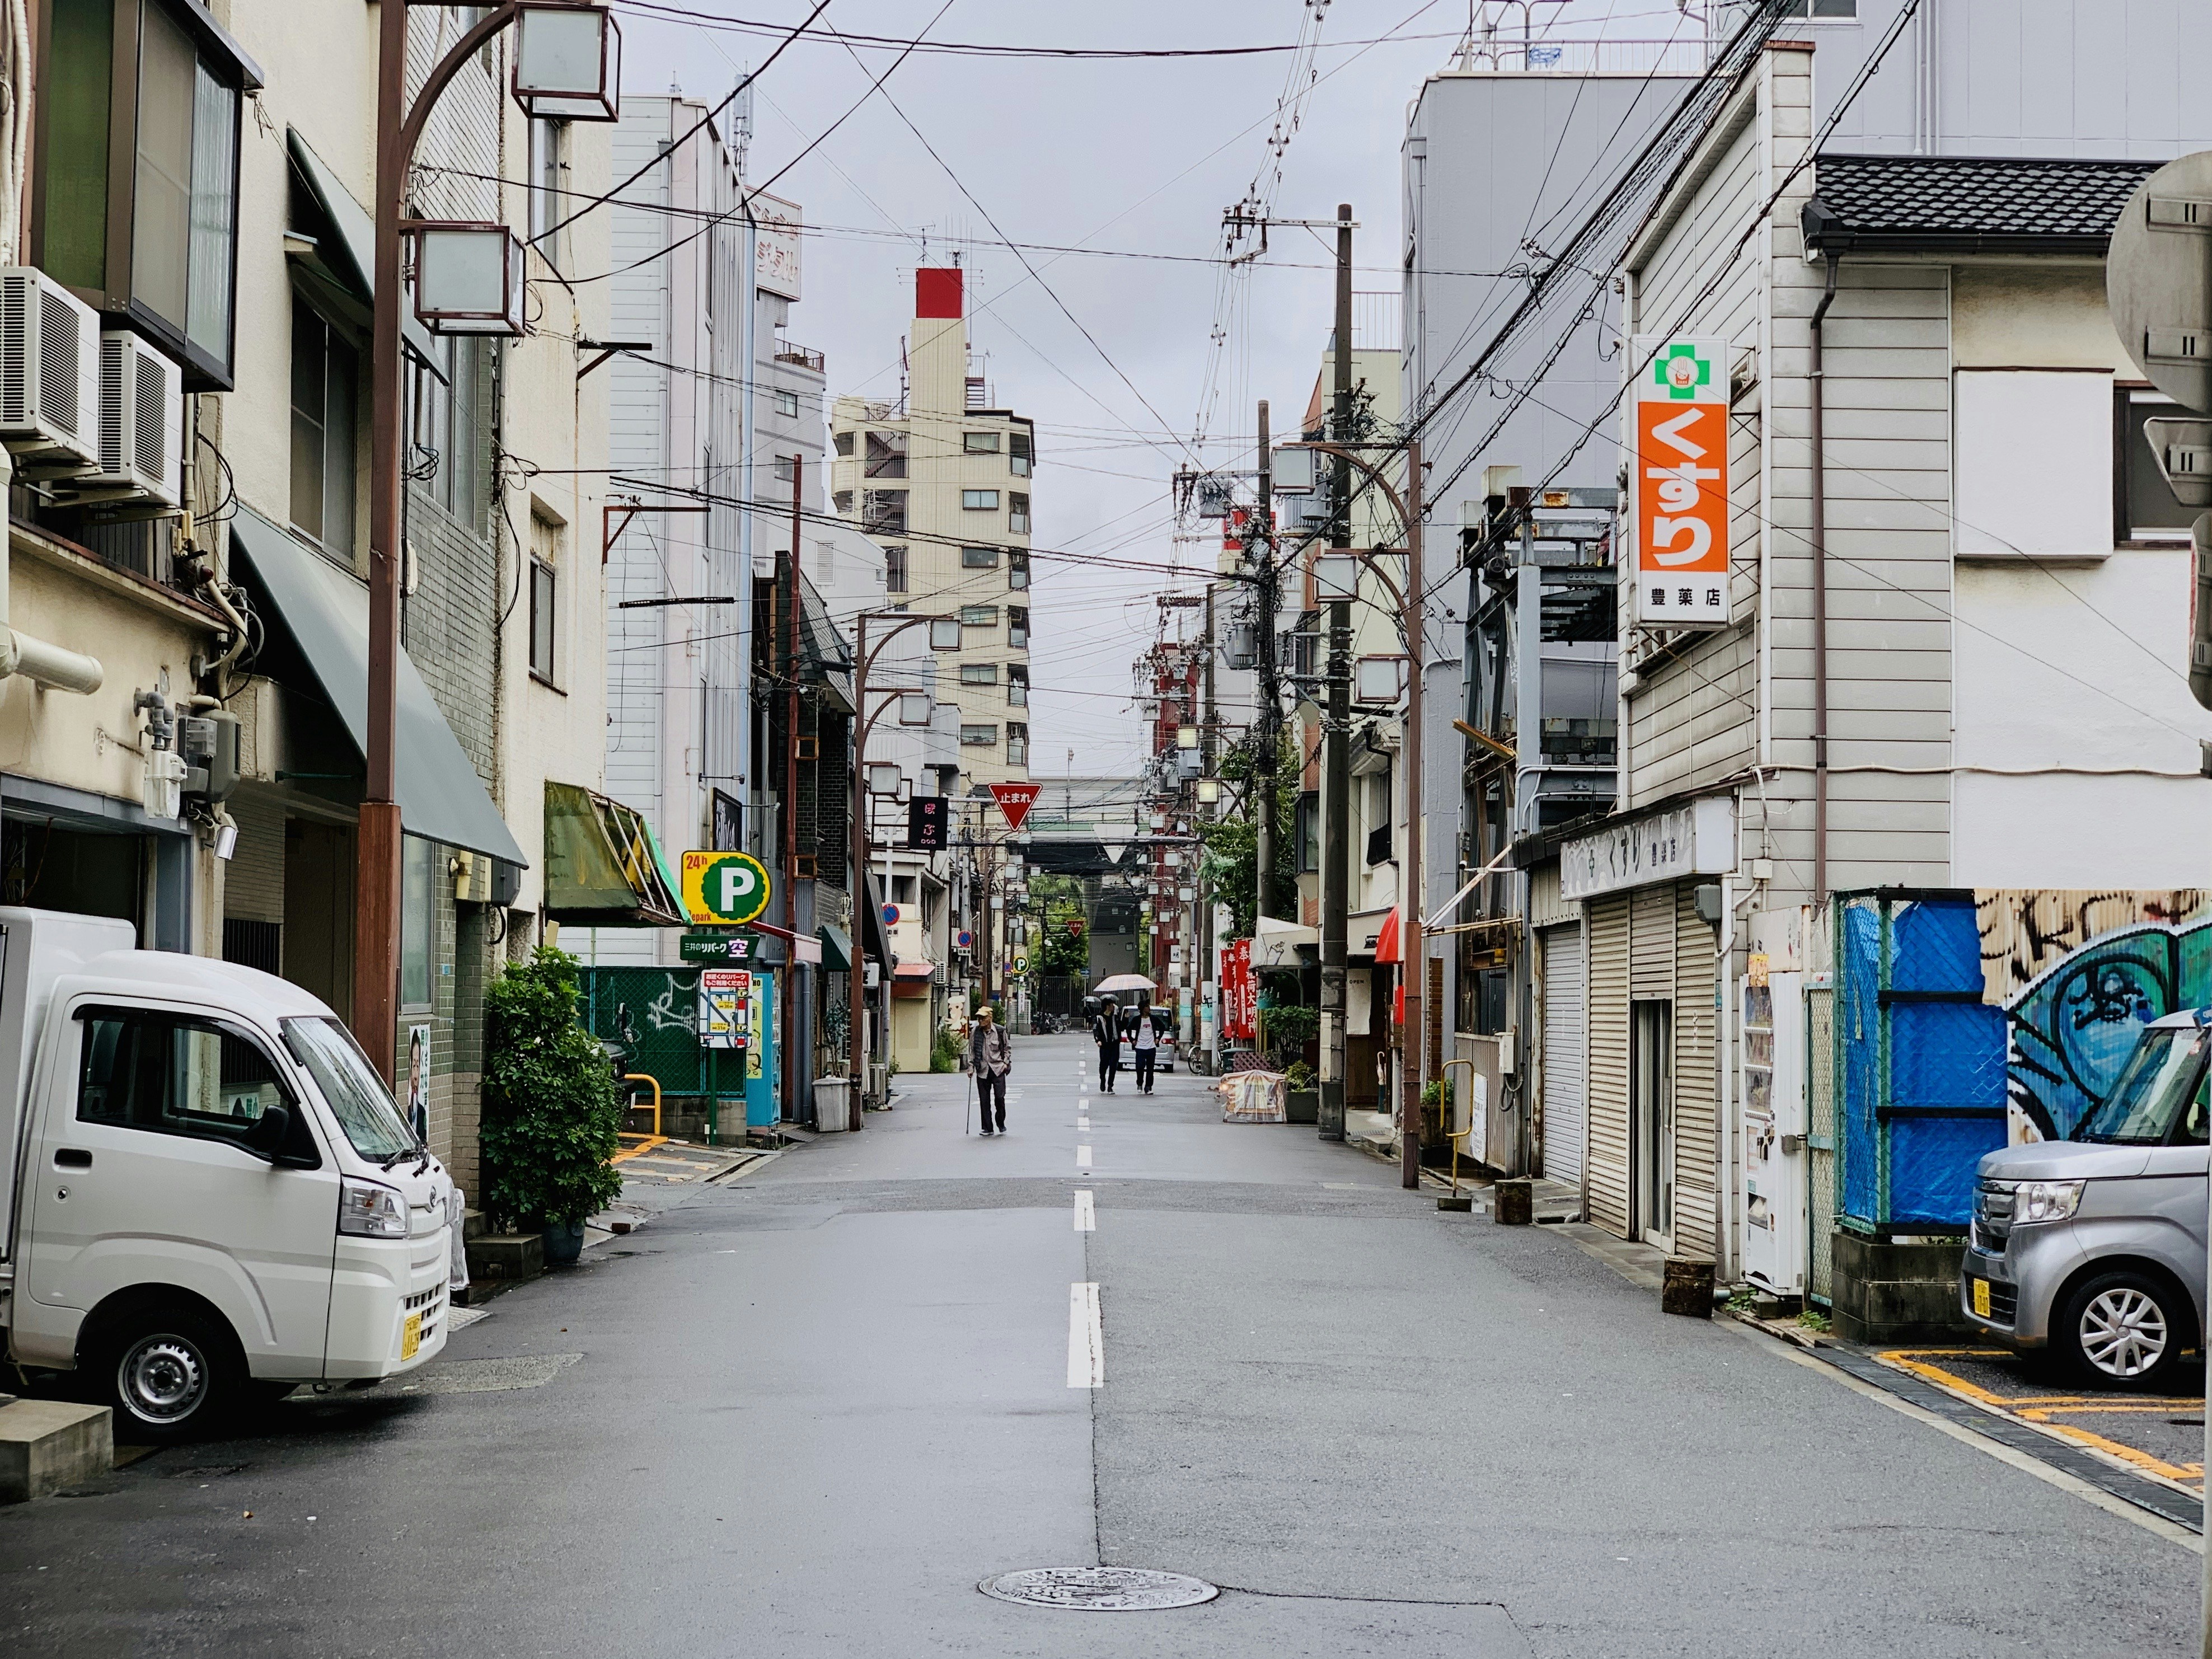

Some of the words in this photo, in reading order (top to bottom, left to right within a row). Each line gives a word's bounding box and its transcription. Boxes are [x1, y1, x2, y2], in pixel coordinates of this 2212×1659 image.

[1646, 407, 1720, 566] くすり
[1651, 588, 1720, 606] 豊薬店
[1000, 793, 1032, 804] 止まれ
[686, 855, 707, 870] 24h
[1609, 829, 1641, 878] くすり
[721, 867, 755, 912] P
[688, 910, 711, 923] epark
[685, 942, 727, 953] 三井のリパーク
[728, 938, 748, 958] 空
[1018, 959, 1026, 970] P
